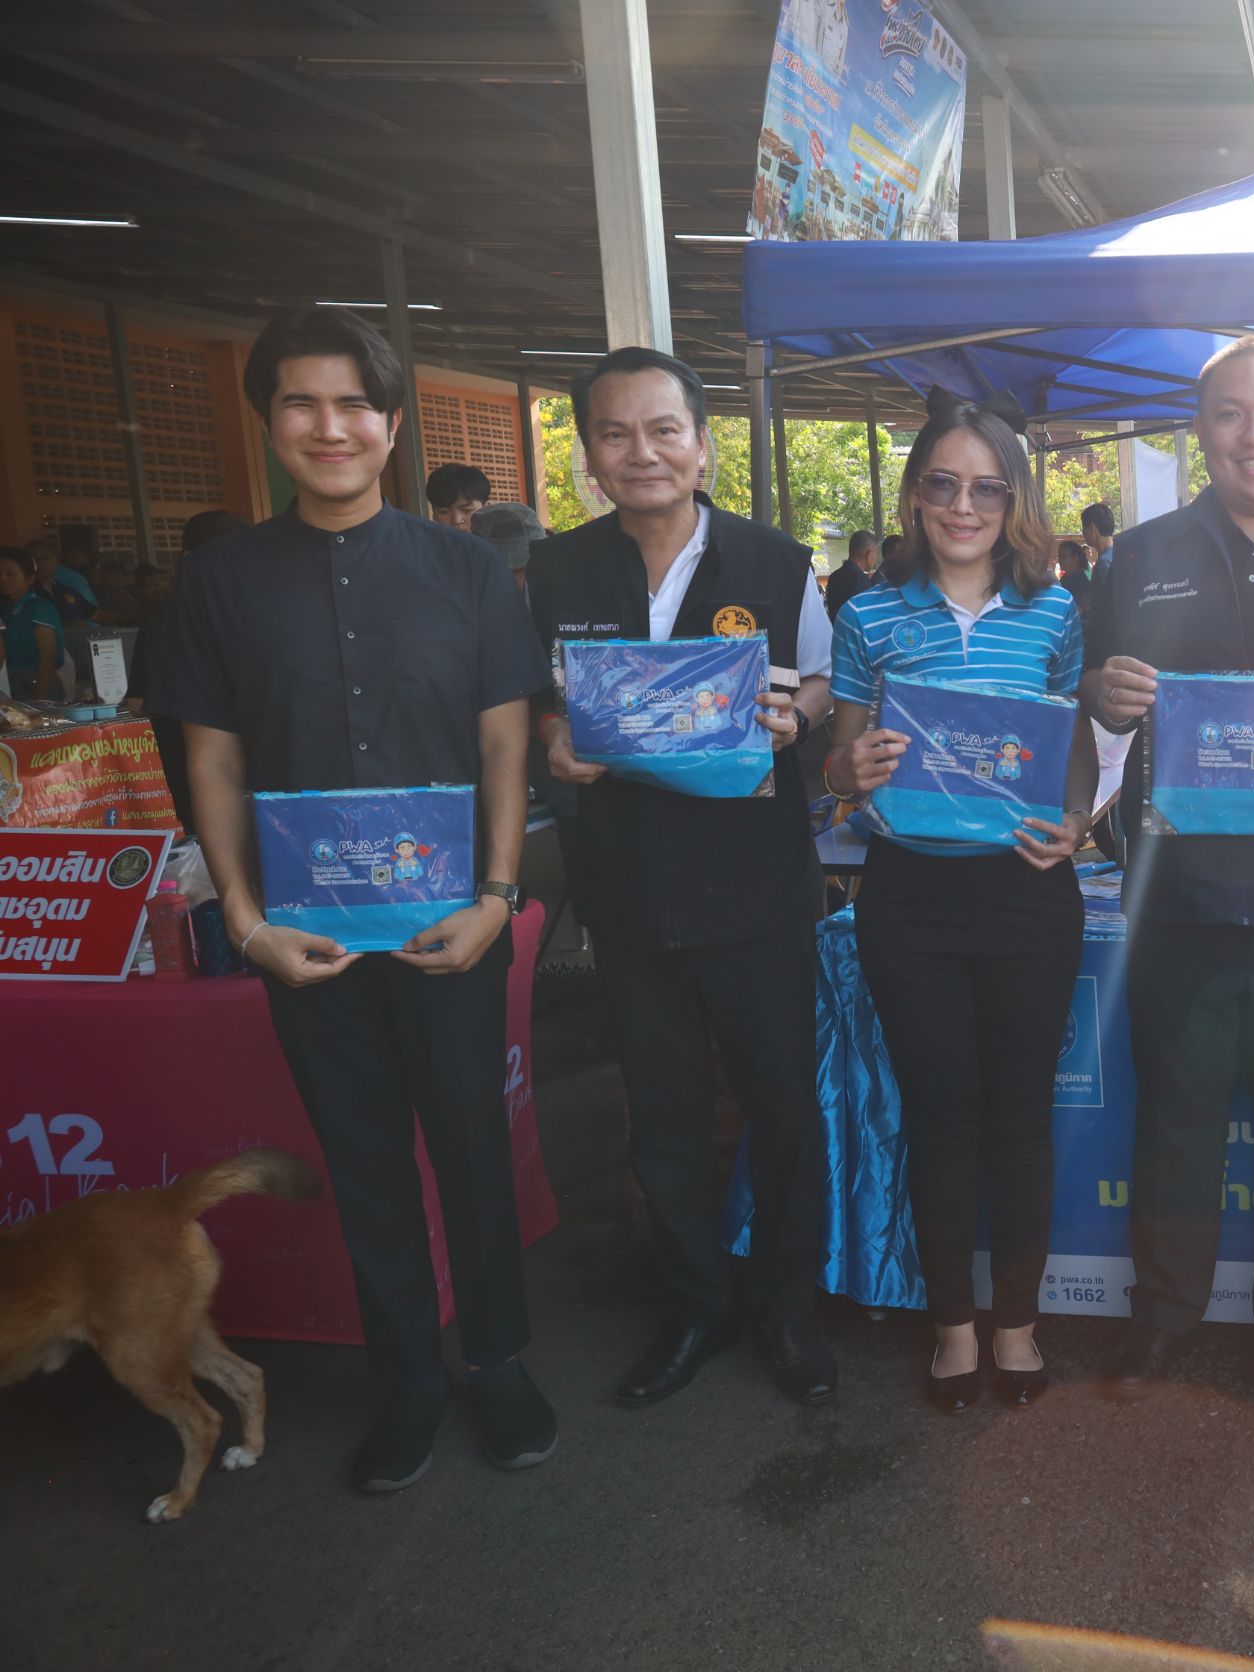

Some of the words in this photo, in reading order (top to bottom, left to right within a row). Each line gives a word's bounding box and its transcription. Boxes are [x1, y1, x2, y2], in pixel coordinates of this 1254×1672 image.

[642, 688, 675, 702] PWA
[1223, 724, 1254, 738] PWA
[951, 731, 982, 747] PWA
[338, 840, 374, 854] PWA
[1062, 1086, 1093, 1095] Authority
[6, 1112, 116, 1176] 12
[1060, 1275, 1104, 1287] pwa.co.th
[1062, 1287, 1107, 1303] 1662
